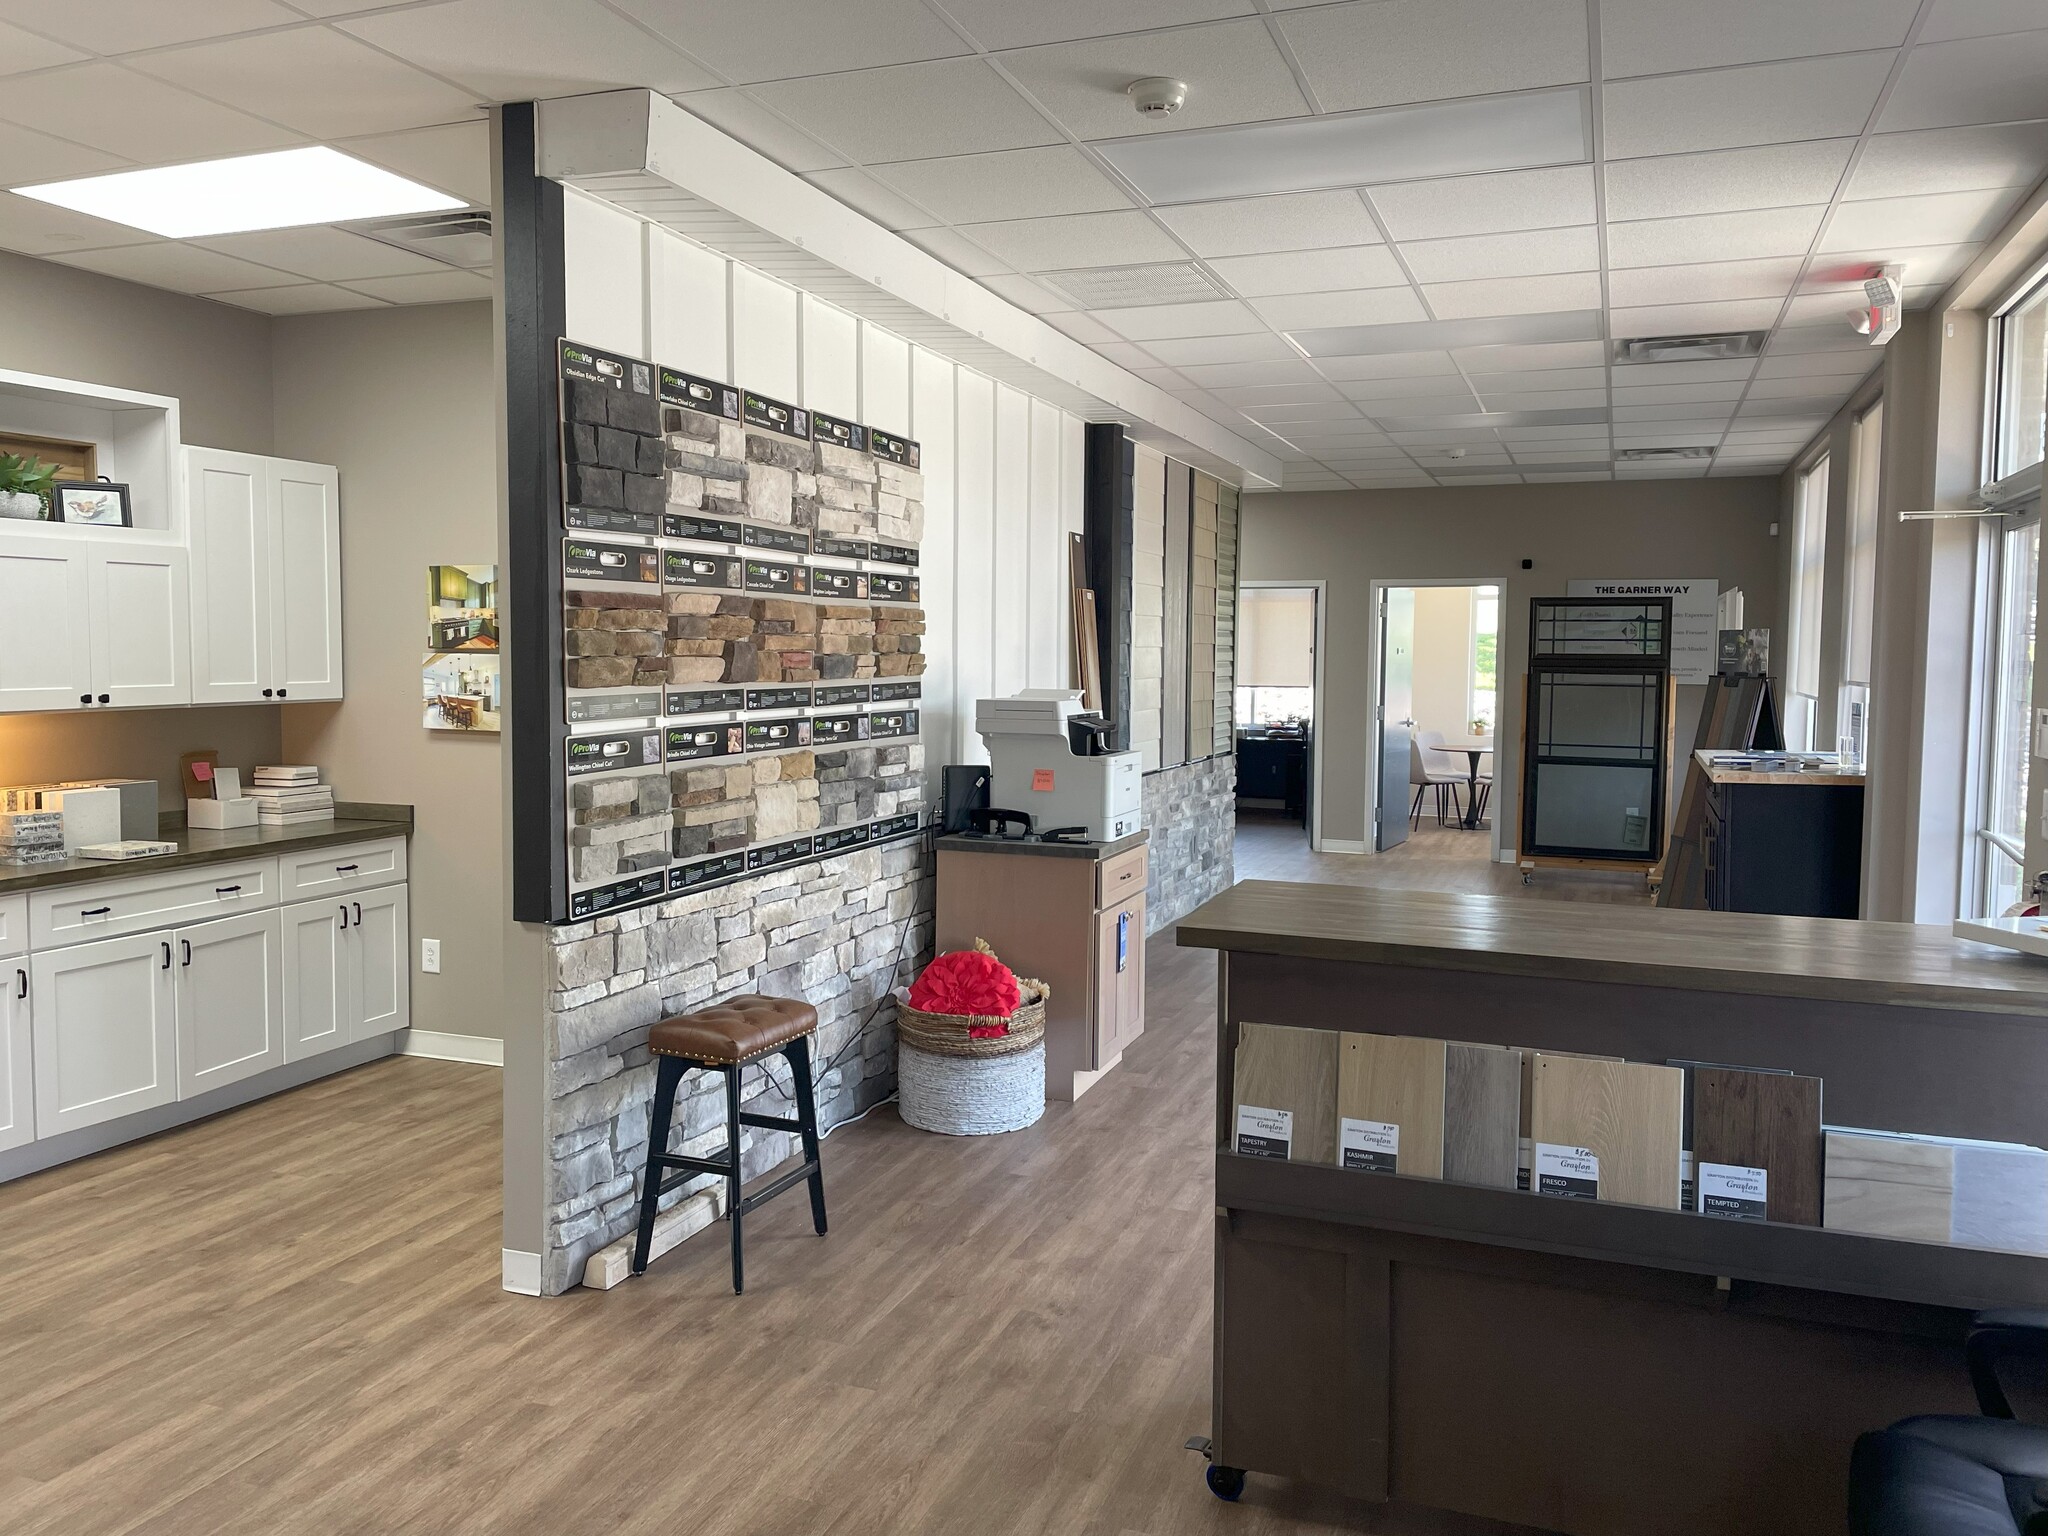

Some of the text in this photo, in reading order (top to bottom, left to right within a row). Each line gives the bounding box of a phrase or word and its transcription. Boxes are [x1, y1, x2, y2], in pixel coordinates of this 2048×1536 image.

[571, 350, 593, 364] ProVia
[566, 368, 606, 383] Obsidian Edge Cut
[668, 375, 687, 388] ProVia
[576, 548, 596, 557] ProVia
[672, 558, 691, 566] ProVia
[579, 568, 604, 576] Ledgestone
[676, 576, 697, 584] Ledgestone
[1594, 586, 1690, 594] THE GARNER WAY
[674, 733, 693, 742] ProVia
[578, 743, 600, 753] ProVia
[568, 763, 592, 772] Wellington
[591, 761, 604, 769] Chisel
[1241, 1137, 1268, 1147] TAPESTRY
[1346, 1151, 1374, 1160] KASHMIR
[1542, 1177, 1567, 1187] FRESCO
[1707, 1198, 1740, 1208] TEMPTED
